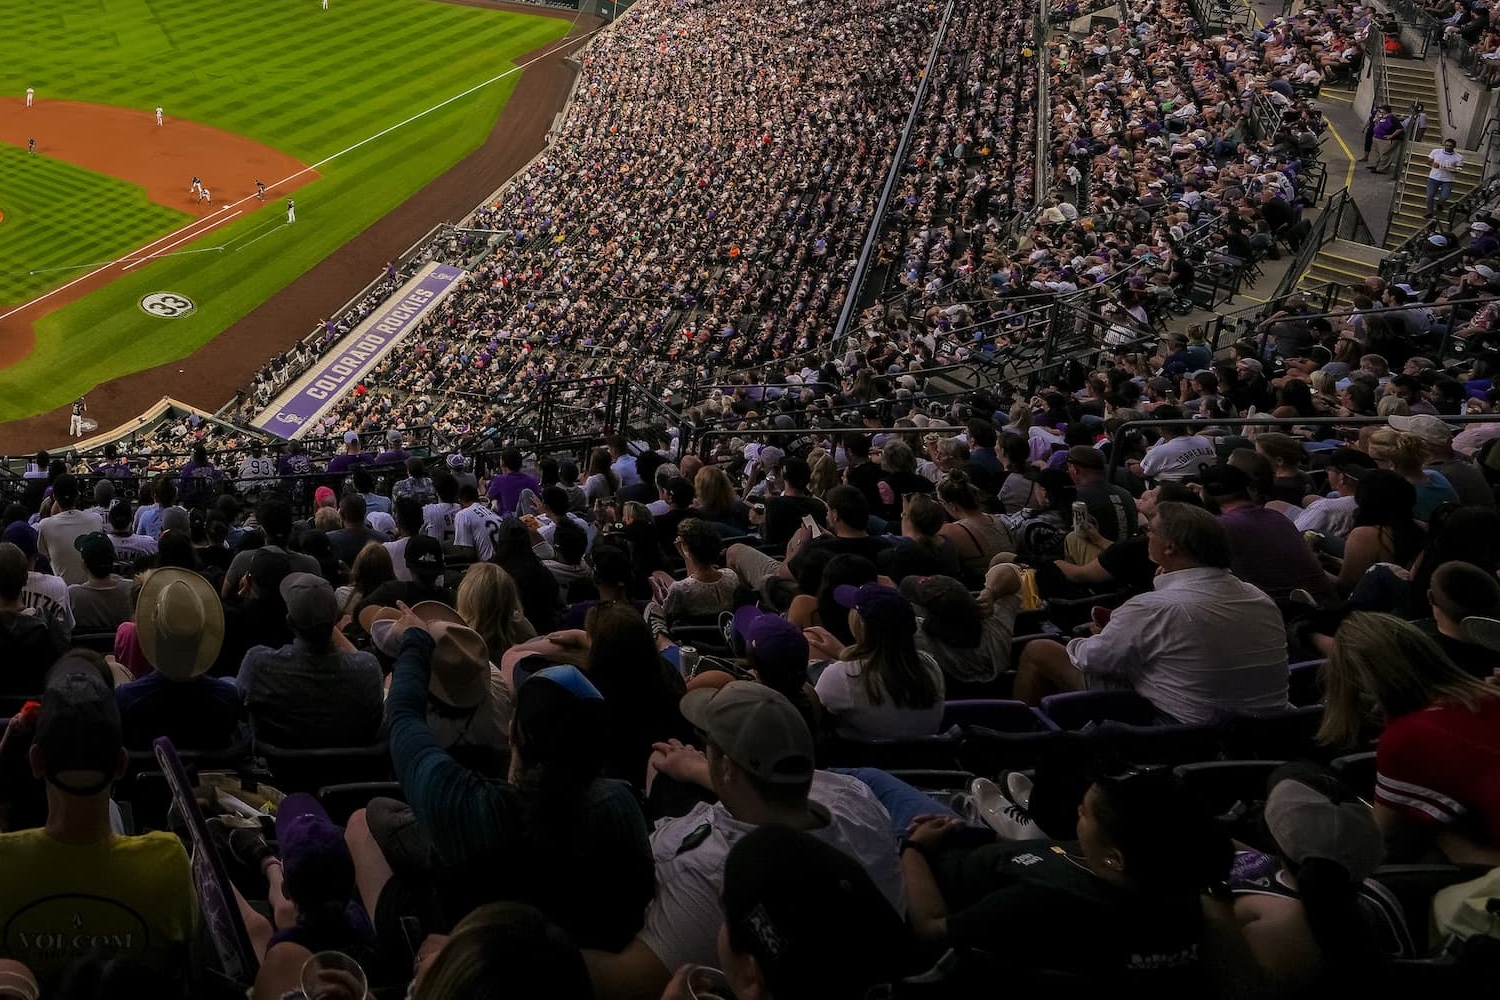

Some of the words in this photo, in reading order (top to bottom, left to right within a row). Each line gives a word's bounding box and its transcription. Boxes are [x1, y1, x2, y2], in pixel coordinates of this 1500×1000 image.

[149, 296, 190, 315] 33
[306, 333, 386, 400] COLORADO
[376, 288, 435, 334] ROCKIES
[251, 460, 270, 475] 93
[19, 931, 132, 950] VOLCOM
